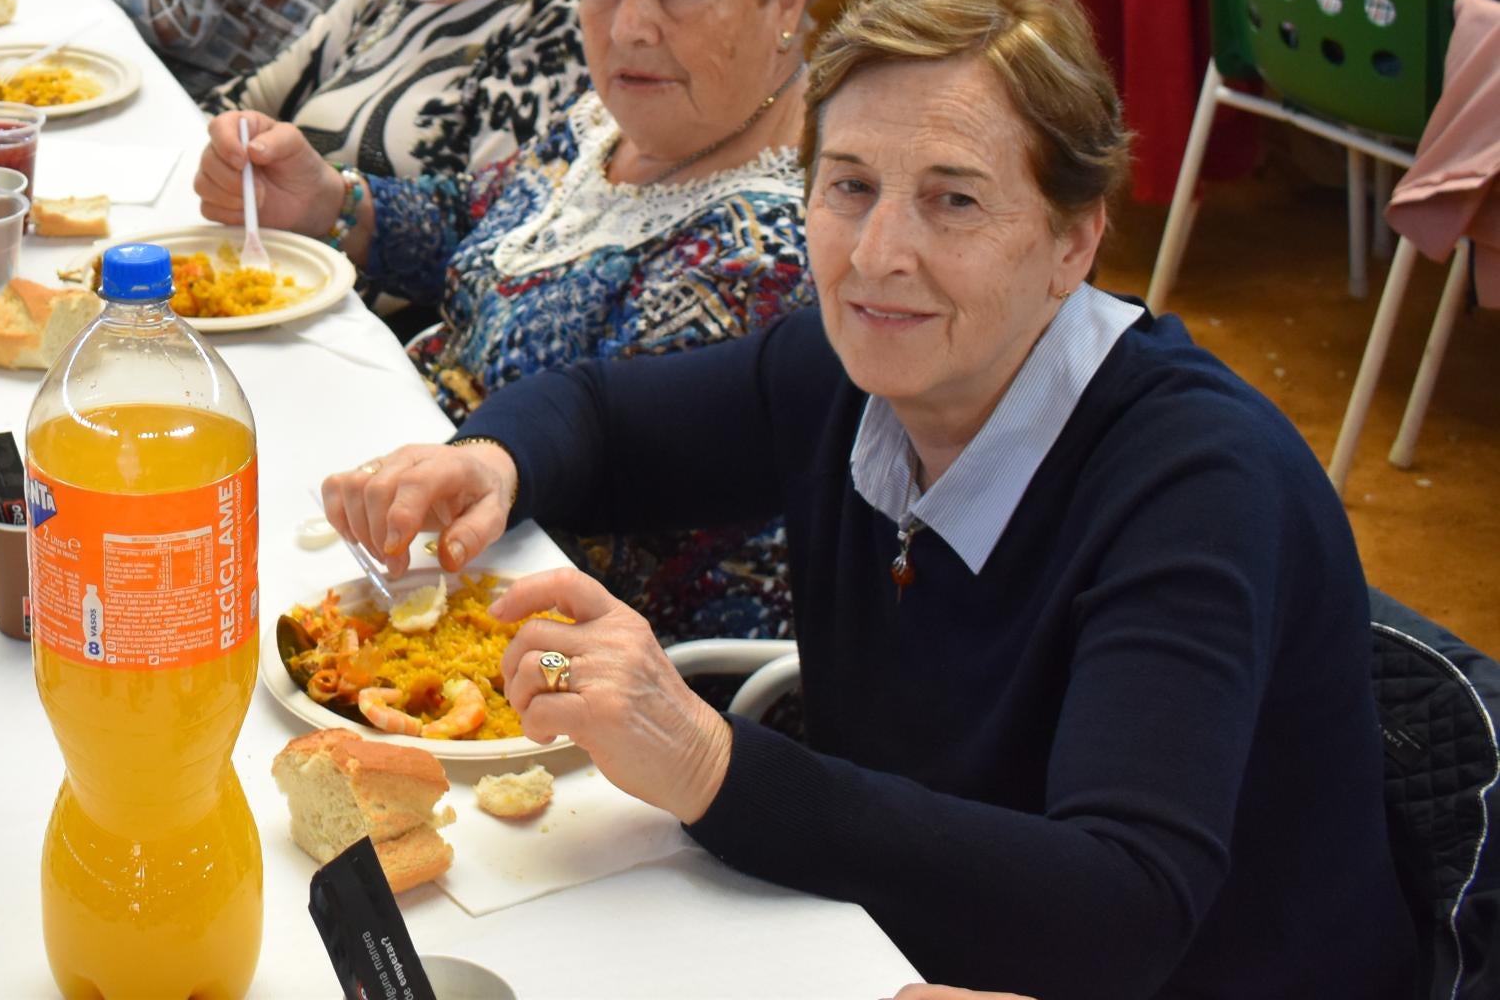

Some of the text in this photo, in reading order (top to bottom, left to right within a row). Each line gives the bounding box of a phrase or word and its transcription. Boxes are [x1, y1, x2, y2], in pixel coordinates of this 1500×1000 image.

[215, 480, 236, 650] RECÍCLAME
[362, 930, 384, 970] manera
[381, 936, 407, 986] empezar?
